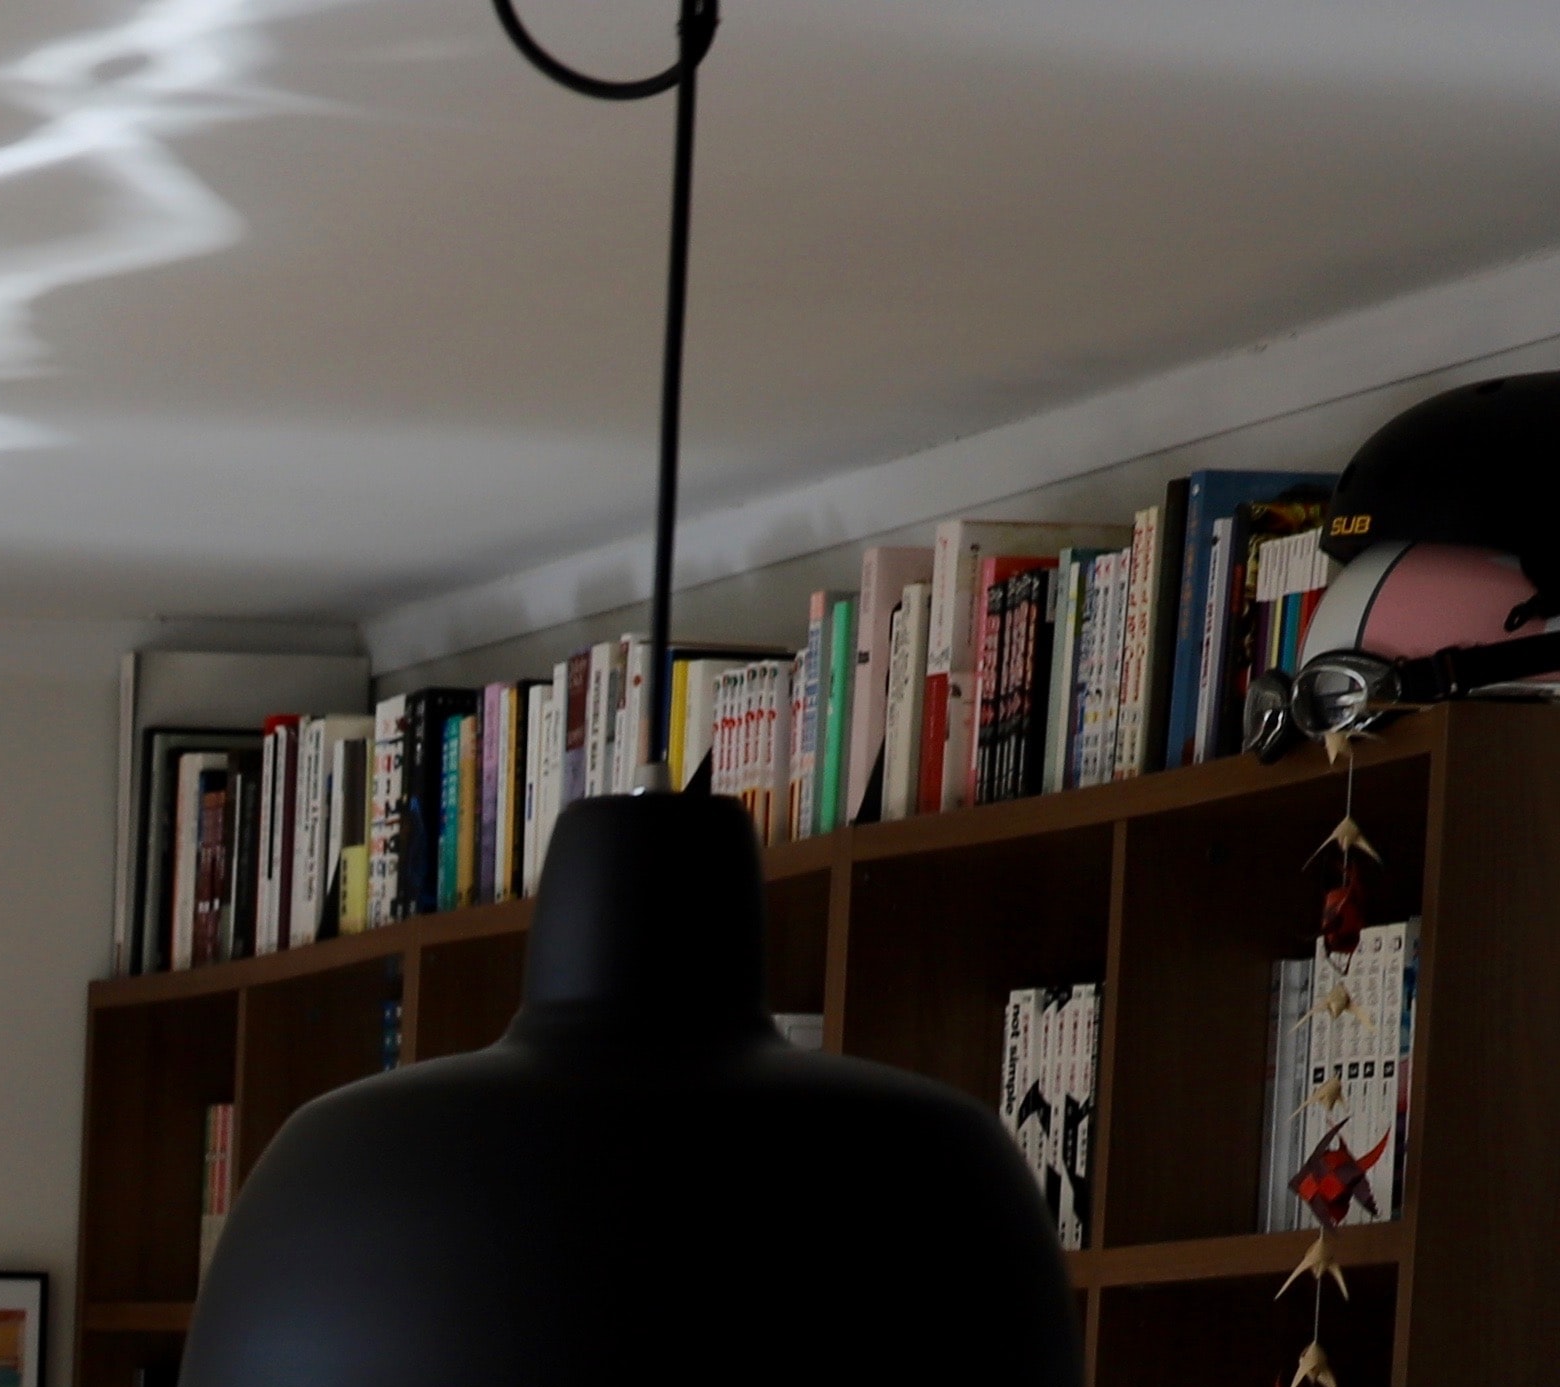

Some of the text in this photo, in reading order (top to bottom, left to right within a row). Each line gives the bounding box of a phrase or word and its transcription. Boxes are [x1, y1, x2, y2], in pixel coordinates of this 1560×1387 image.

[1330, 514, 1373, 538] SUB
[1006, 1003, 1020, 1116] not simple
